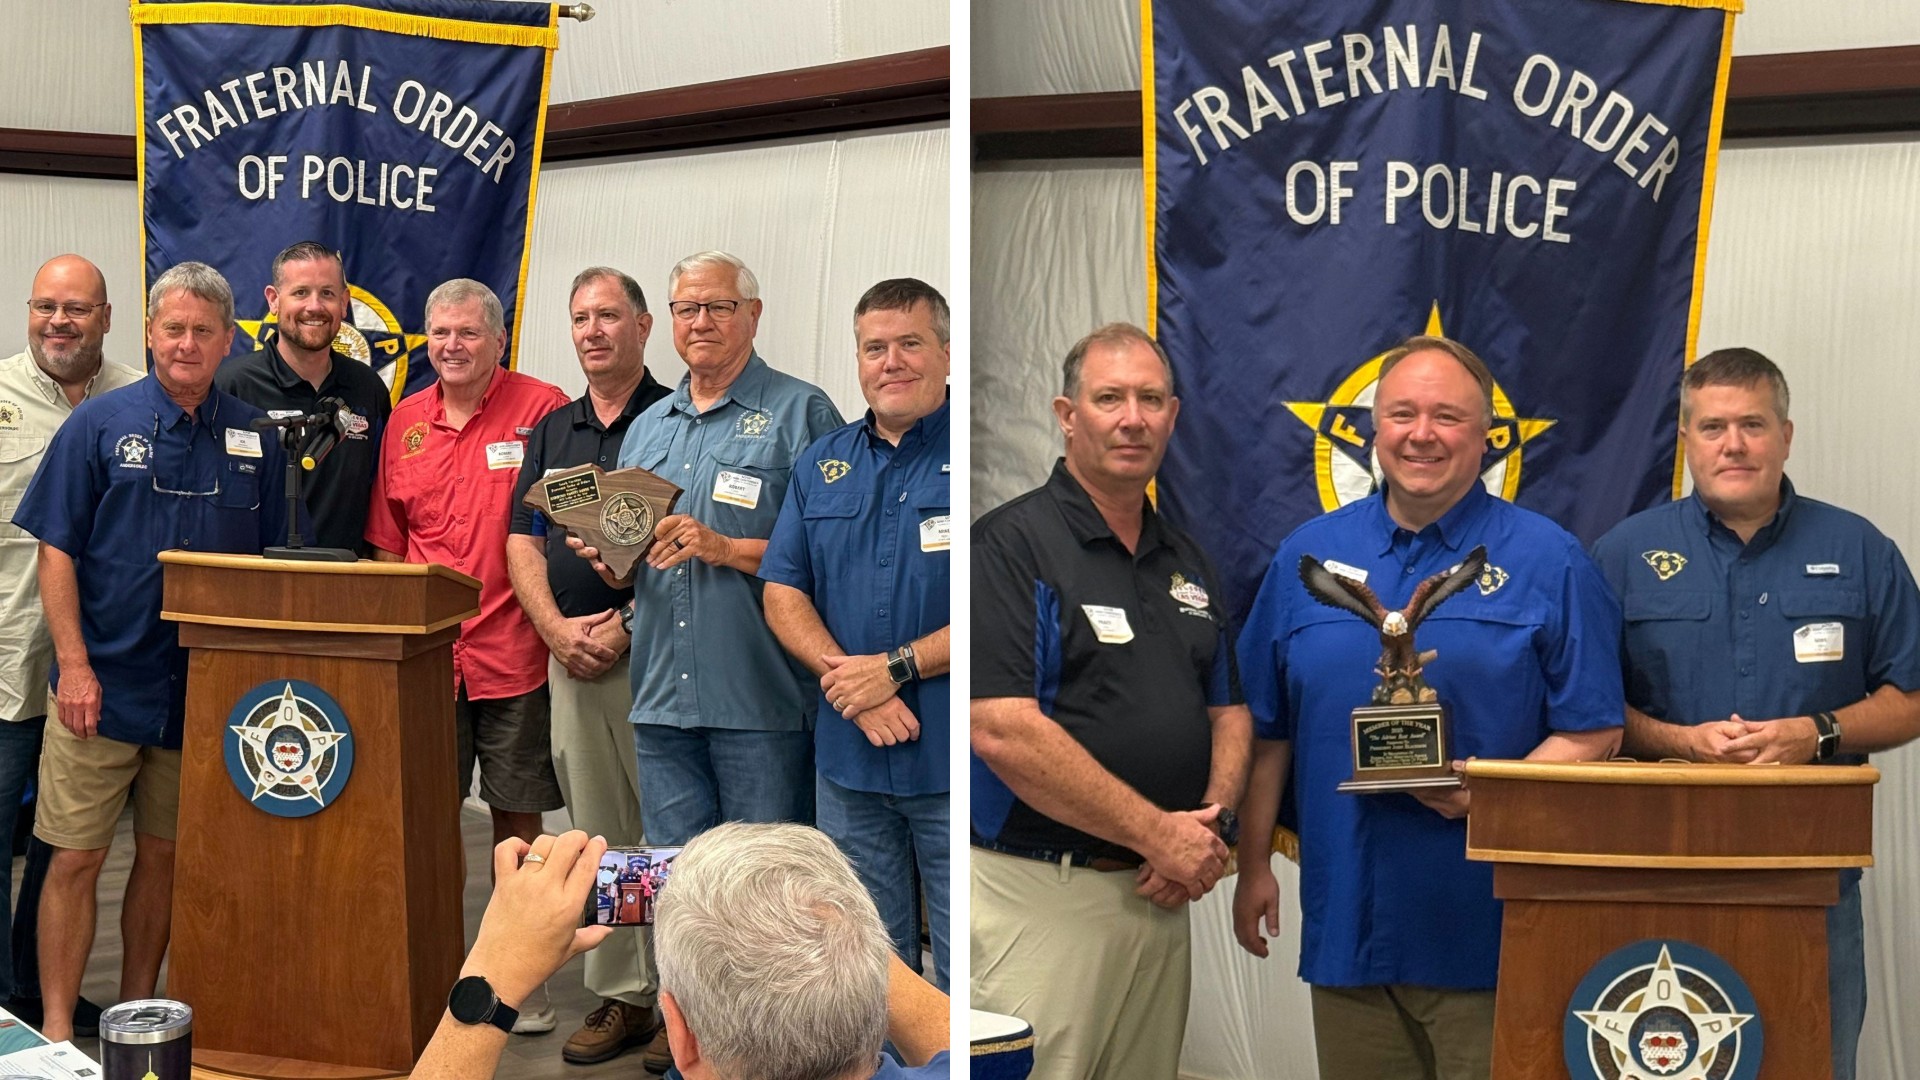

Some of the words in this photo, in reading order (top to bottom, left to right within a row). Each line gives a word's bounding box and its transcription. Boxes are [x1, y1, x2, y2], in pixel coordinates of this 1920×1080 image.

[156, 60, 377, 159] FRATERNAL
[392, 80, 516, 184] ORDER
[1173, 24, 1488, 165] FRATERNAL
[1512, 54, 1679, 202] ORDER
[238, 155, 287, 200] OF
[302, 155, 438, 212] POLICE
[1284, 160, 1358, 225] OF
[1385, 160, 1577, 243] POLICE
[339, 325, 368, 359] BERTATUM
[374, 338, 399, 355] P
[1329, 413, 1365, 448] F
[1486, 425, 1511, 449] P
[284, 706, 293, 721] O
[250, 732, 263, 743] F
[312, 736, 326, 746] P
[1657, 979, 1670, 1000] O
[1604, 1018, 1624, 1034] F
[1701, 1020, 1723, 1033] P
